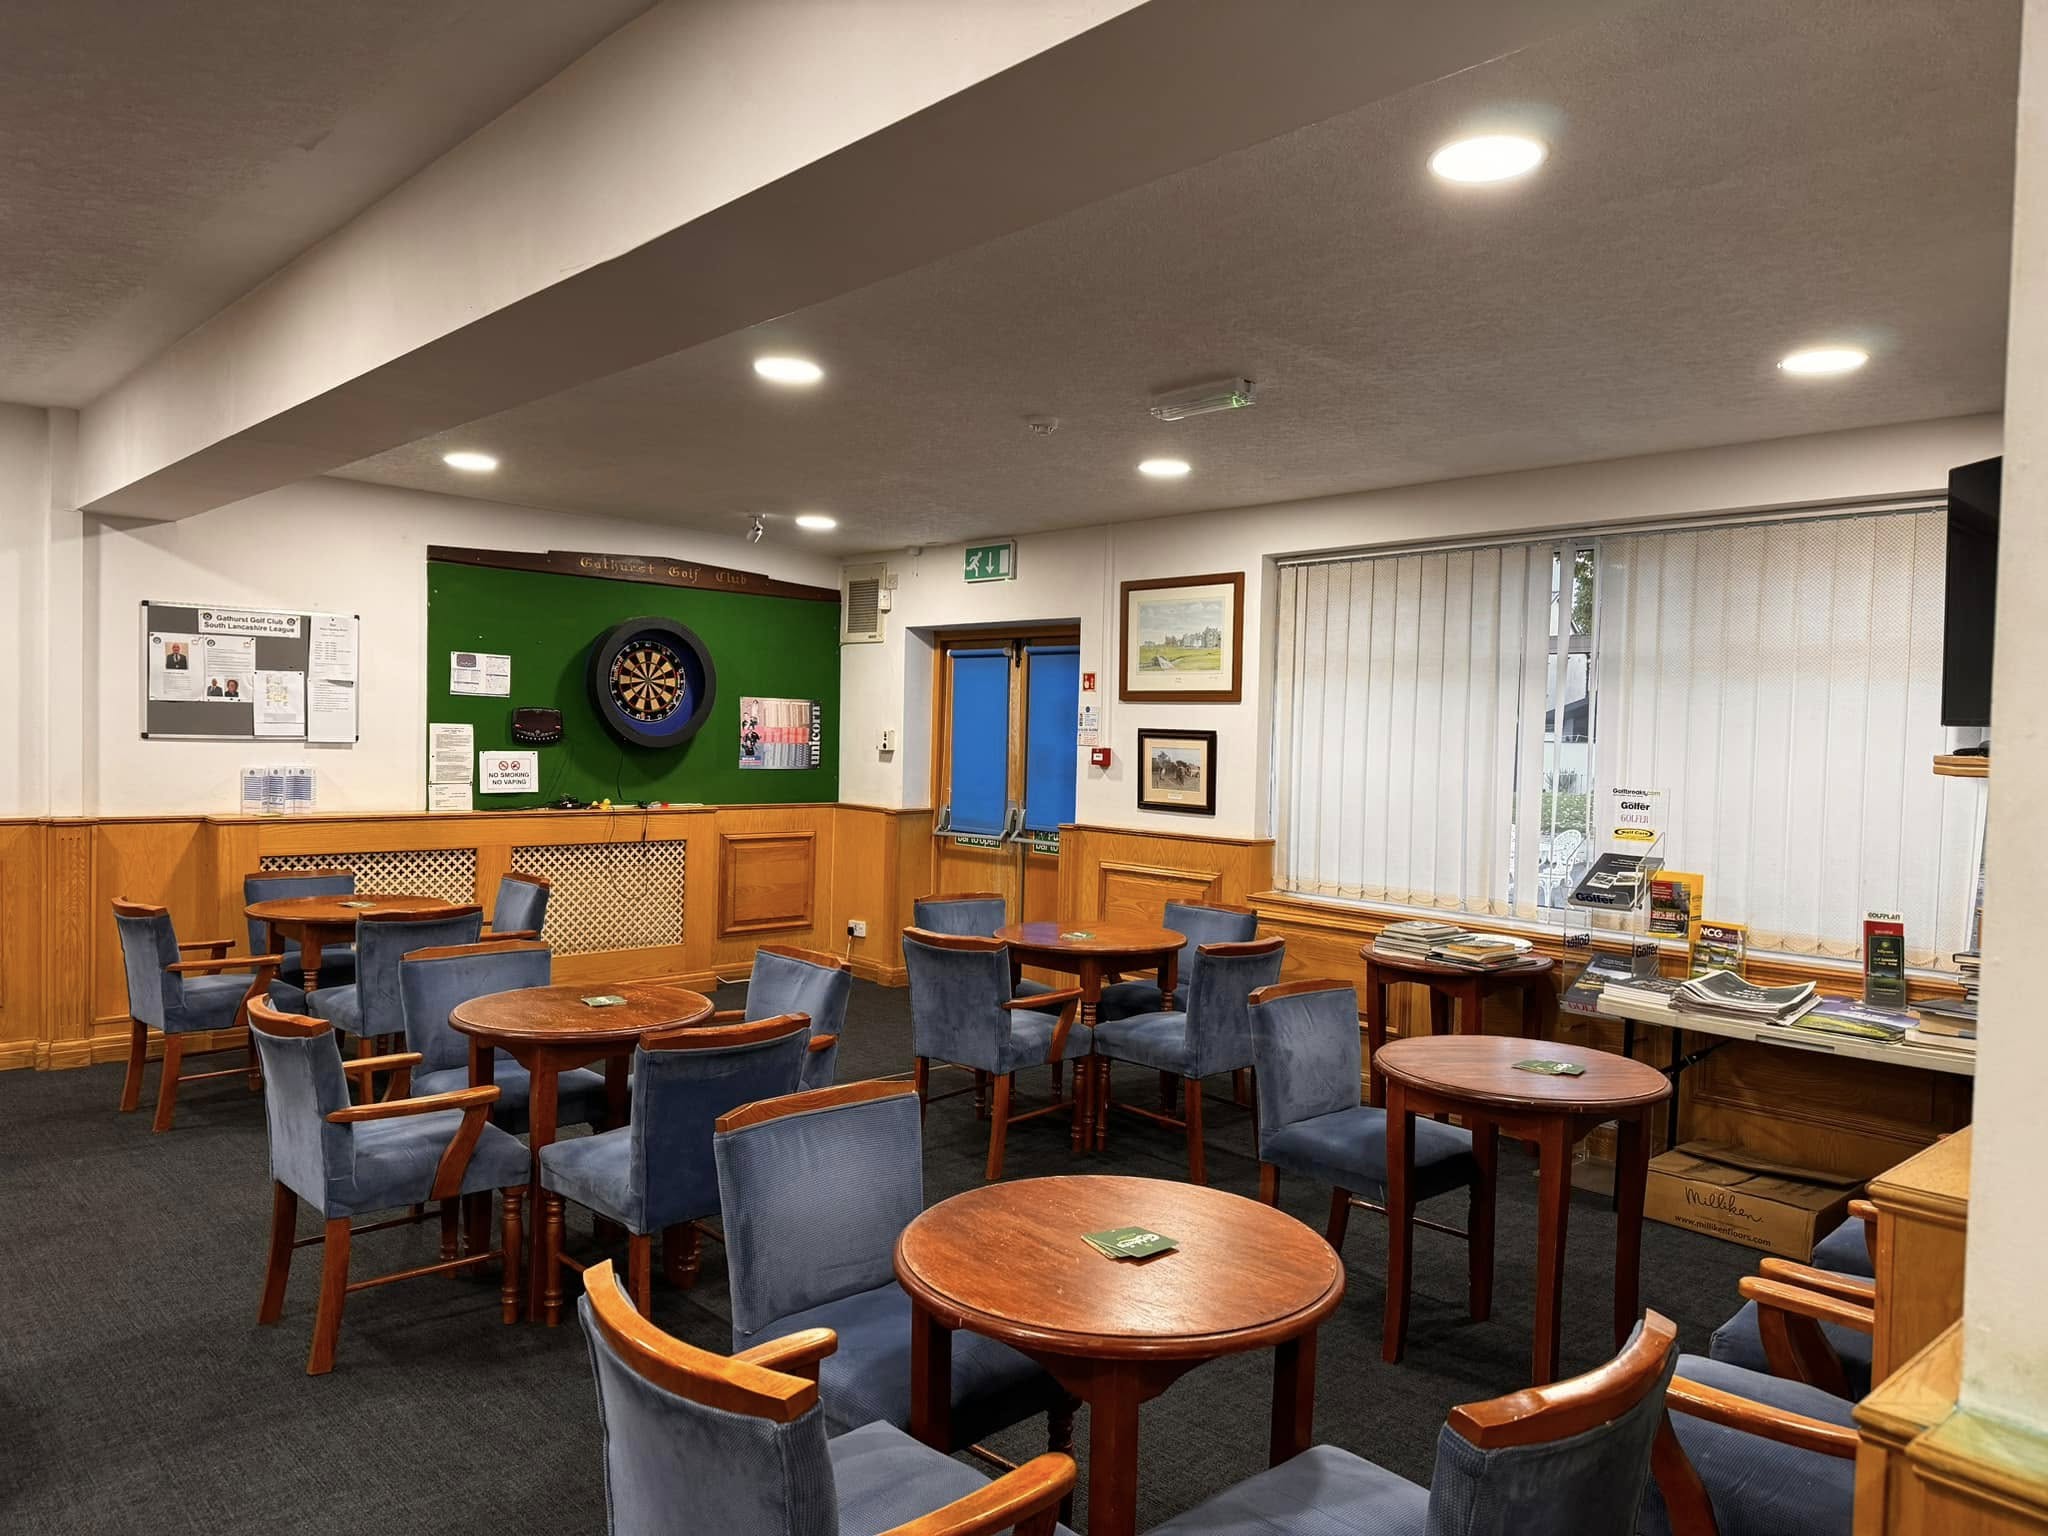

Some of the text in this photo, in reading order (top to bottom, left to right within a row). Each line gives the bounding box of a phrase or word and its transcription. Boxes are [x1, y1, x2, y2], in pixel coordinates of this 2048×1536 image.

[580, 556, 747, 585] Gathurst Golf Club
[216, 614, 248, 623] Gathurst
[250, 616, 265, 624] Golf
[204, 621, 295, 634] South Lancashire League
[809, 703, 820, 765] unicorn
[1620, 801, 1651, 811] Golfer
[1575, 892, 1616, 905] Golfer
[1700, 927, 1723, 938] NCG
[1635, 943, 1658, 957] Golfer
[1684, 1186, 1763, 1223] Milliken
[1674, 1213, 1771, 1246] www.millikenfloors.com
